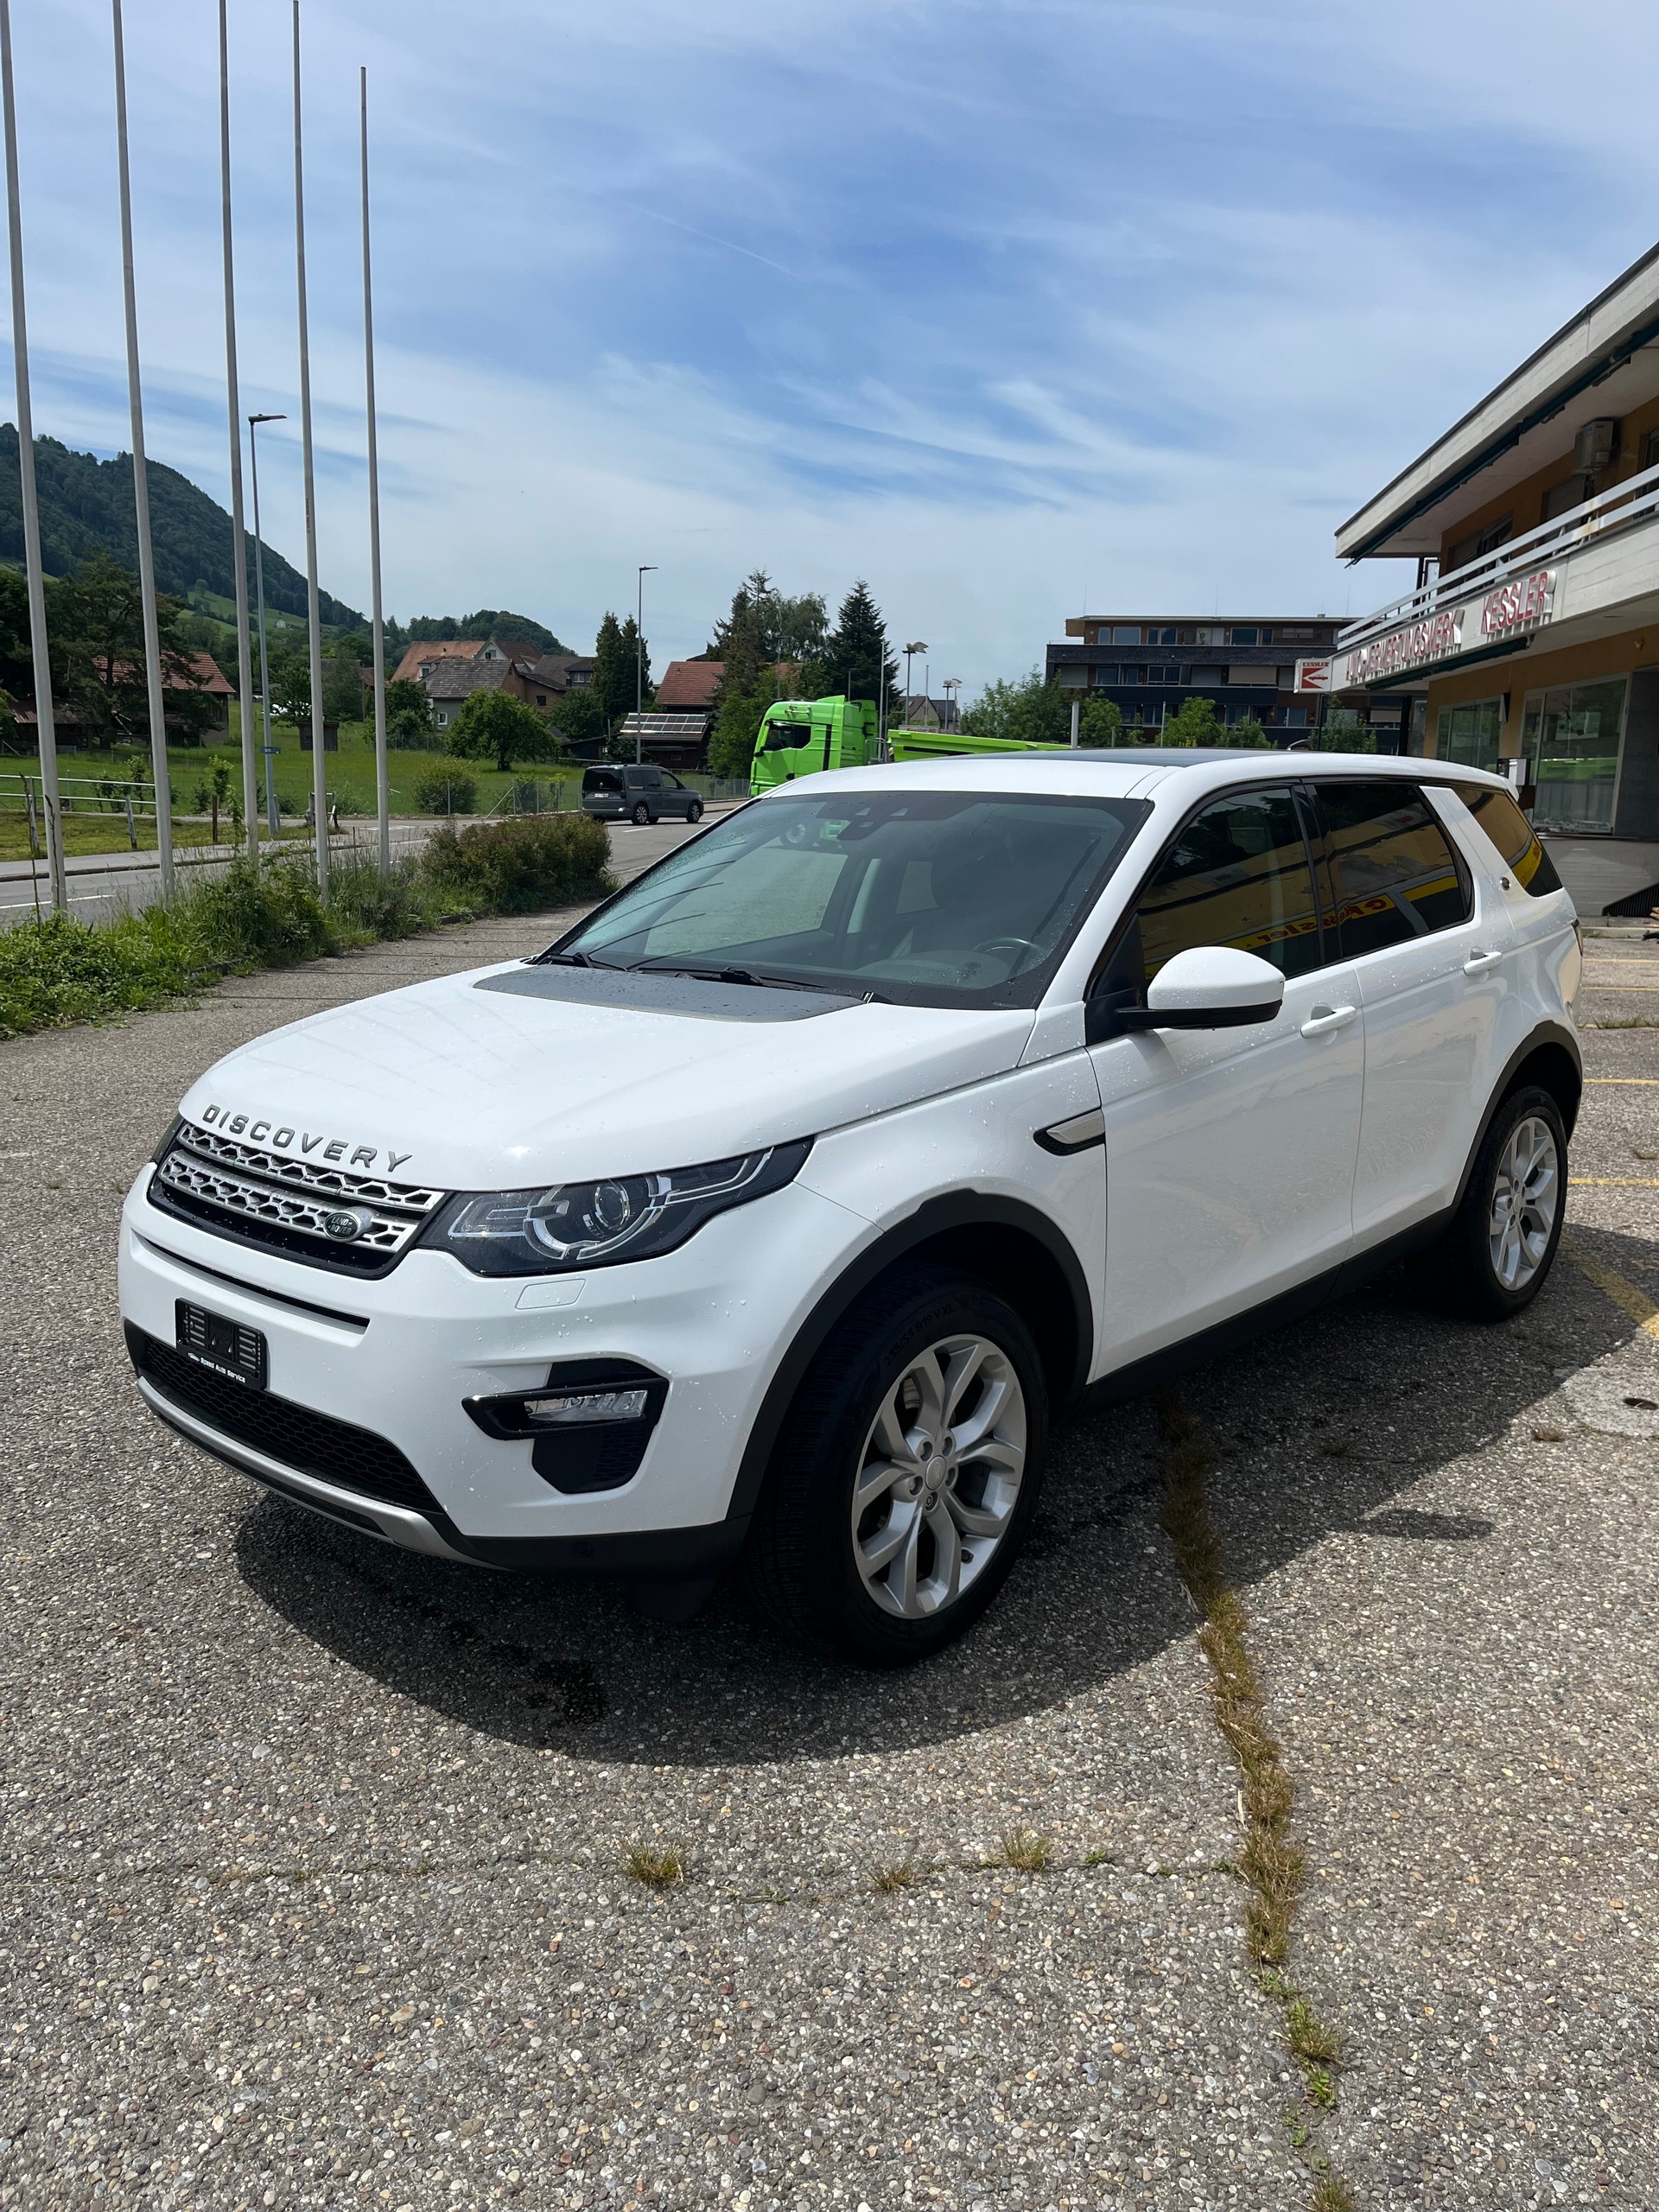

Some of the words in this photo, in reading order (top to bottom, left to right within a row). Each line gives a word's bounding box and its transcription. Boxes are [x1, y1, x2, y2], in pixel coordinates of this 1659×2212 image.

[1481, 570, 1556, 634] KESSLER
[202, 1104, 412, 1173] DISCOVERY
[226, 1370, 246, 1383] Service
